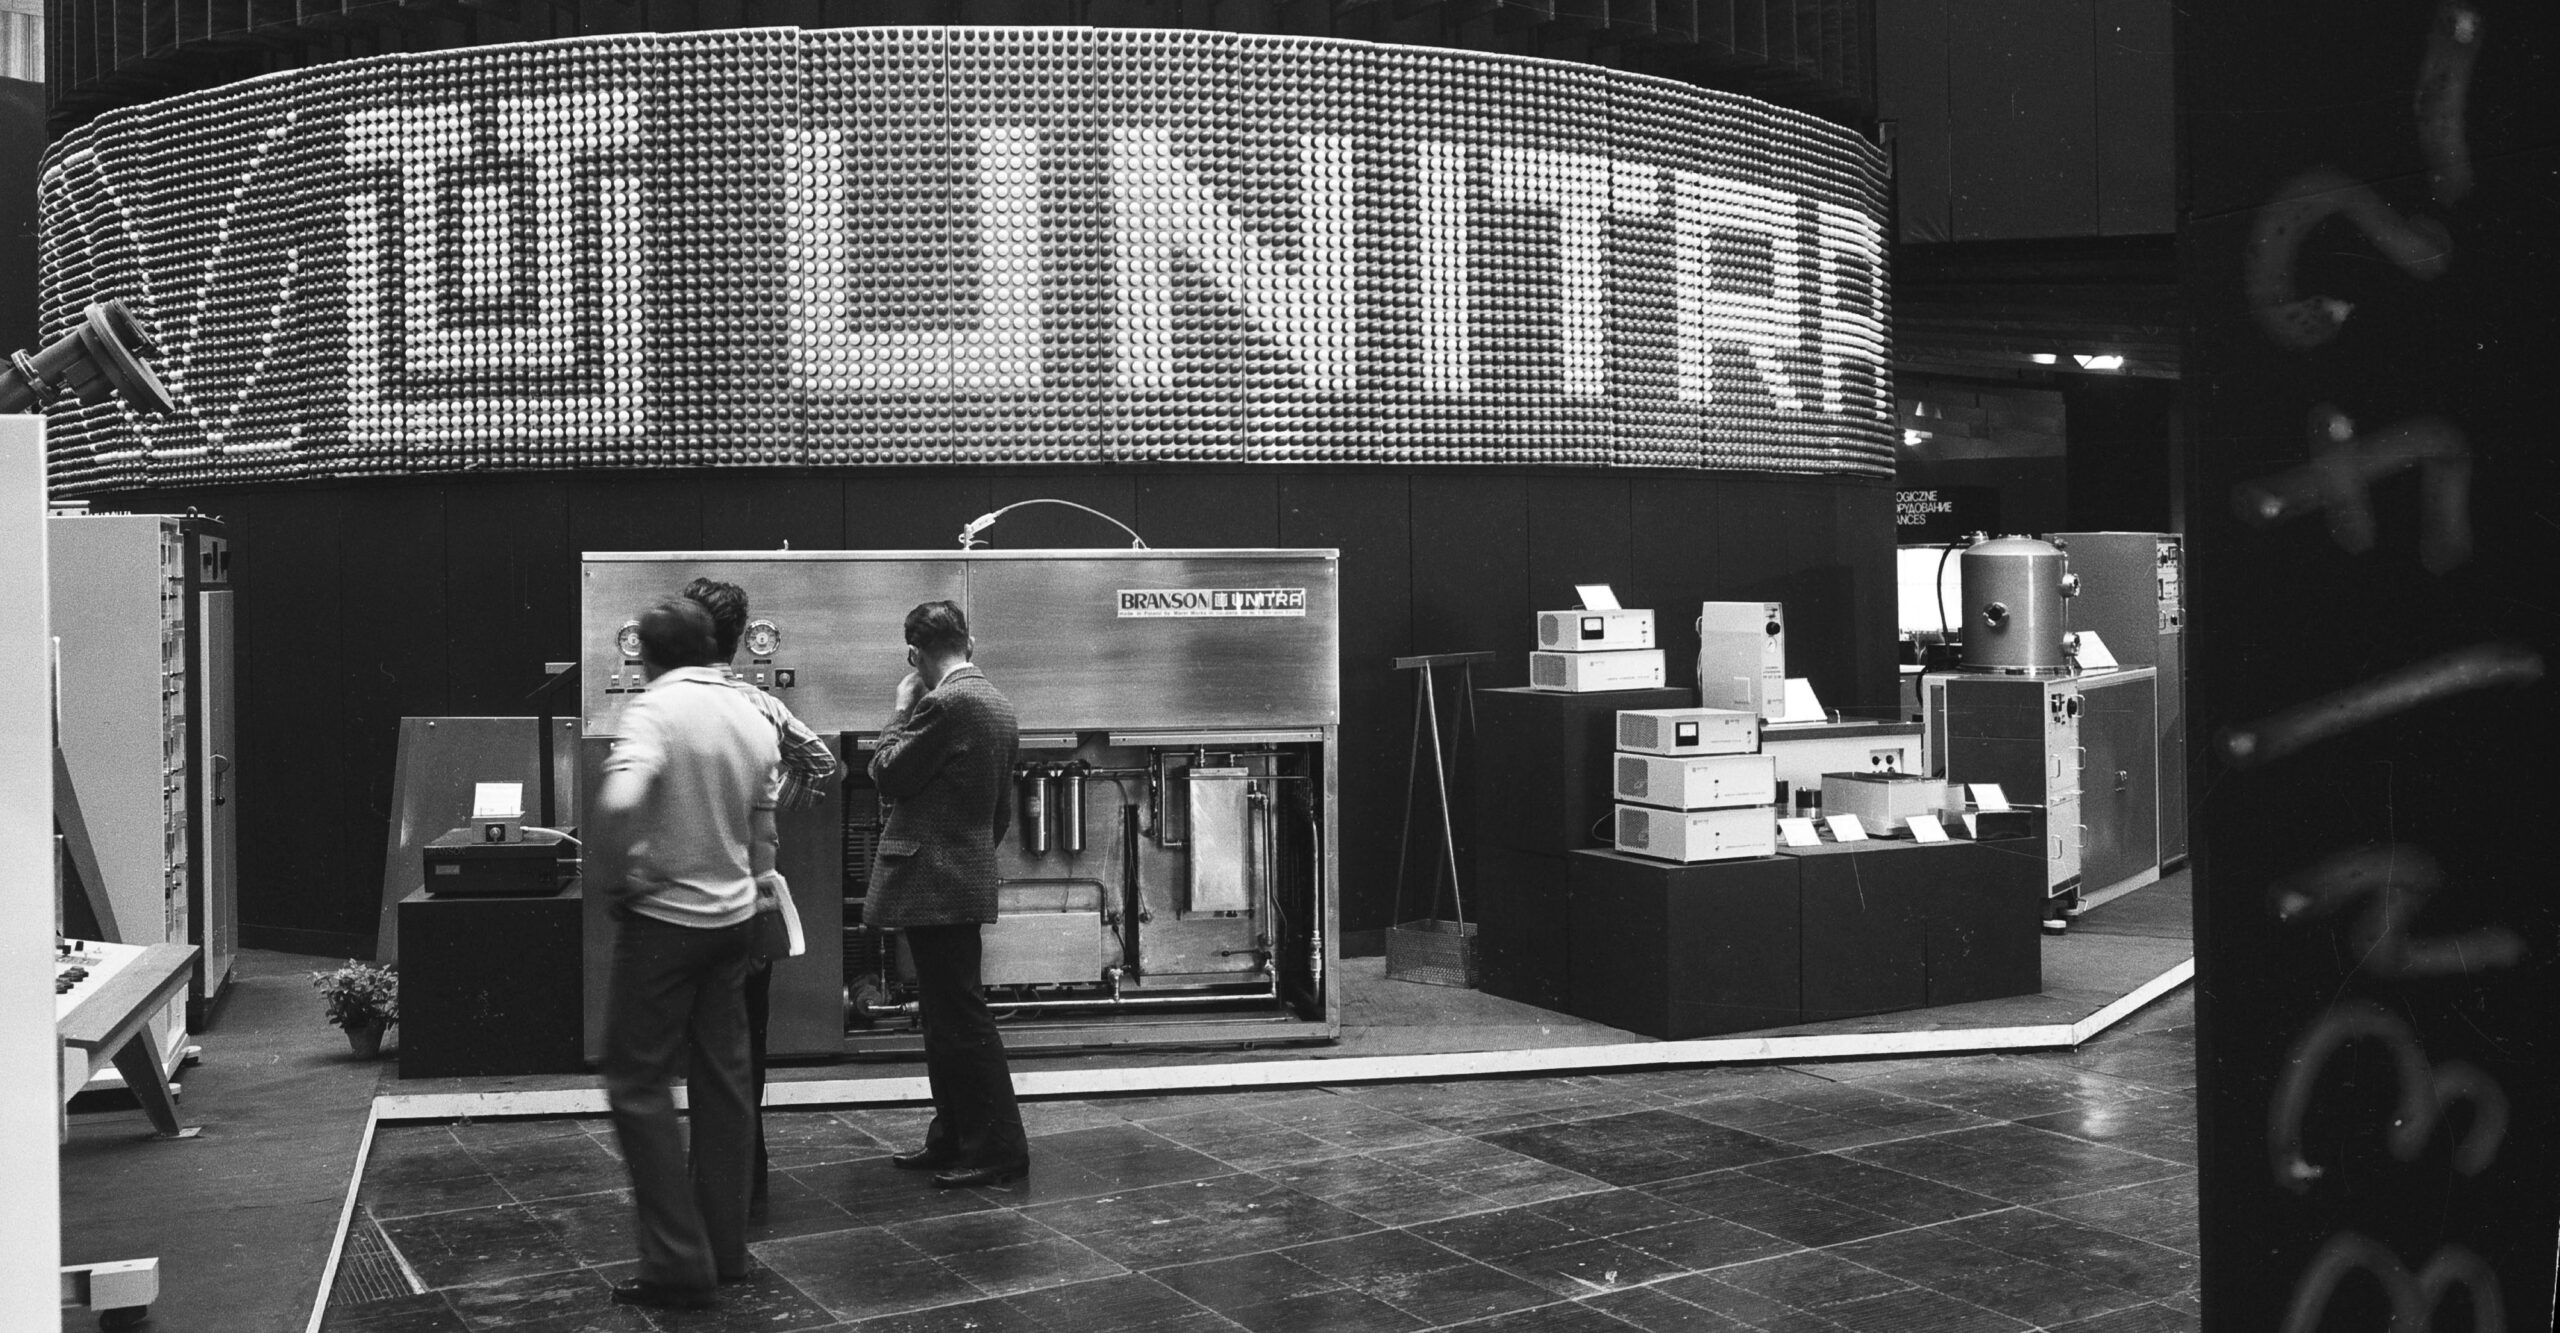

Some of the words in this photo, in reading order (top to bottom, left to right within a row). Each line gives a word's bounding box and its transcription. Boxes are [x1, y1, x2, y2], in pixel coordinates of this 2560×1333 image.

[783, 126, 1888, 421] UNITRA
[1121, 592, 1209, 609] BRANSON
[1231, 591, 1303, 608] UNITRA
